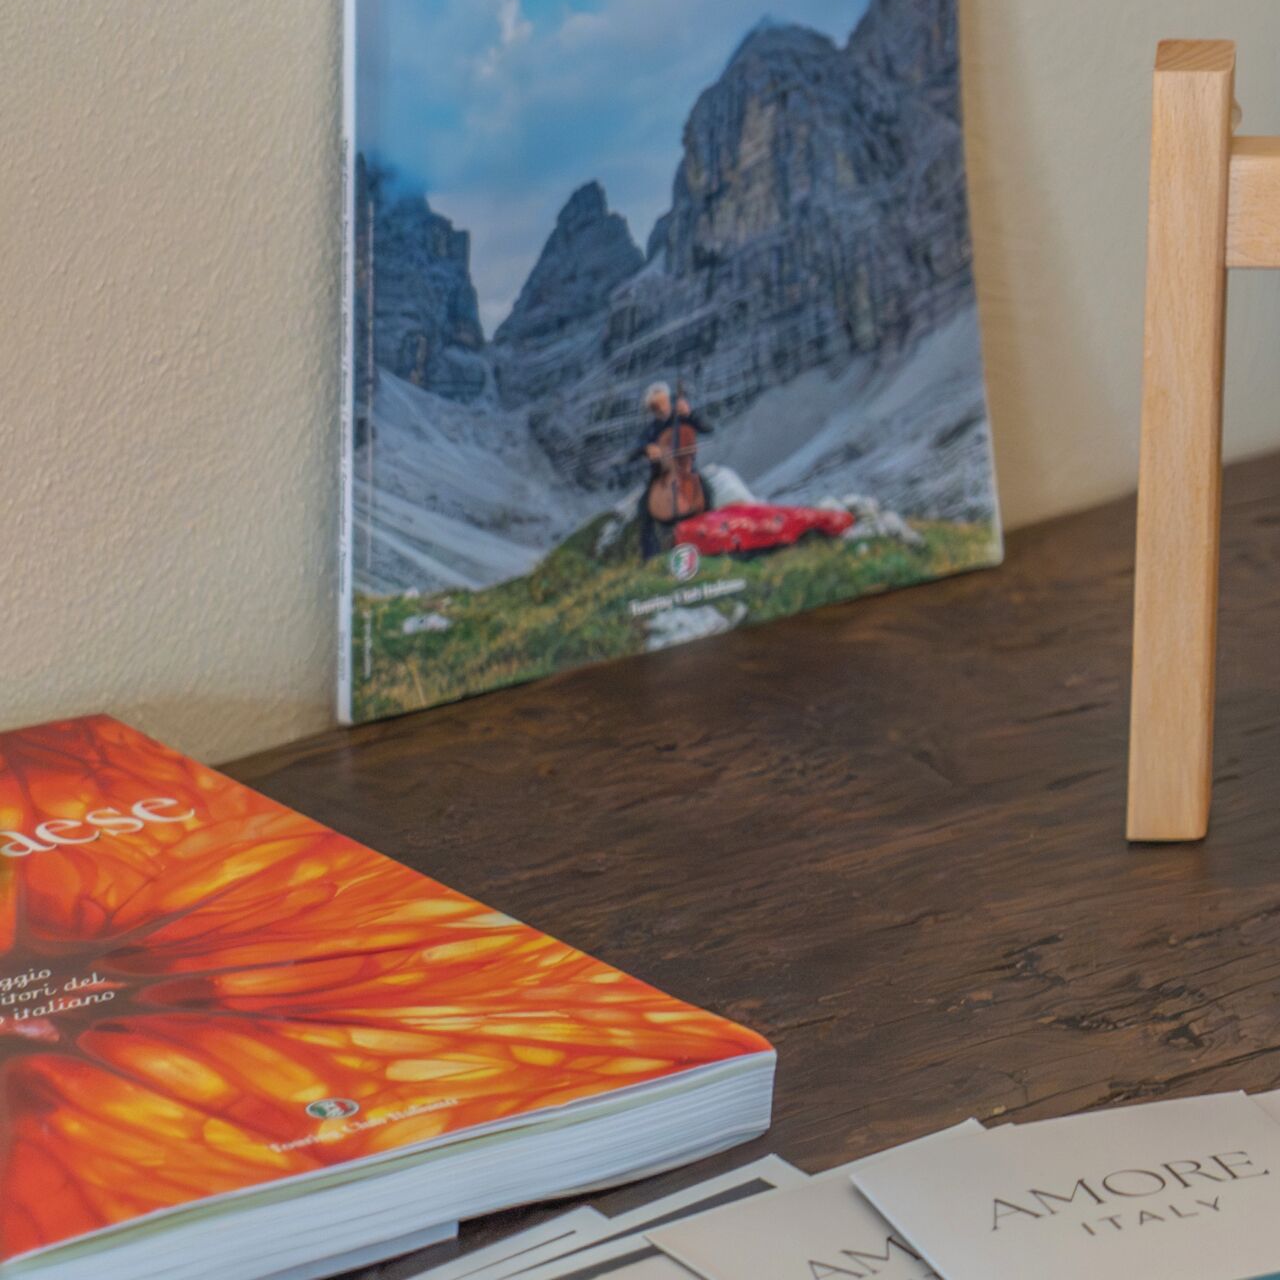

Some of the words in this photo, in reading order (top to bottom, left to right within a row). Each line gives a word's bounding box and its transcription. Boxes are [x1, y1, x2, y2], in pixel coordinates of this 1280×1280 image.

[63, 972, 105, 992] del
[14, 990, 115, 1021] italiano
[991, 1150, 1271, 1231] AMORE
[1080, 1195, 1222, 1237] ITALY
